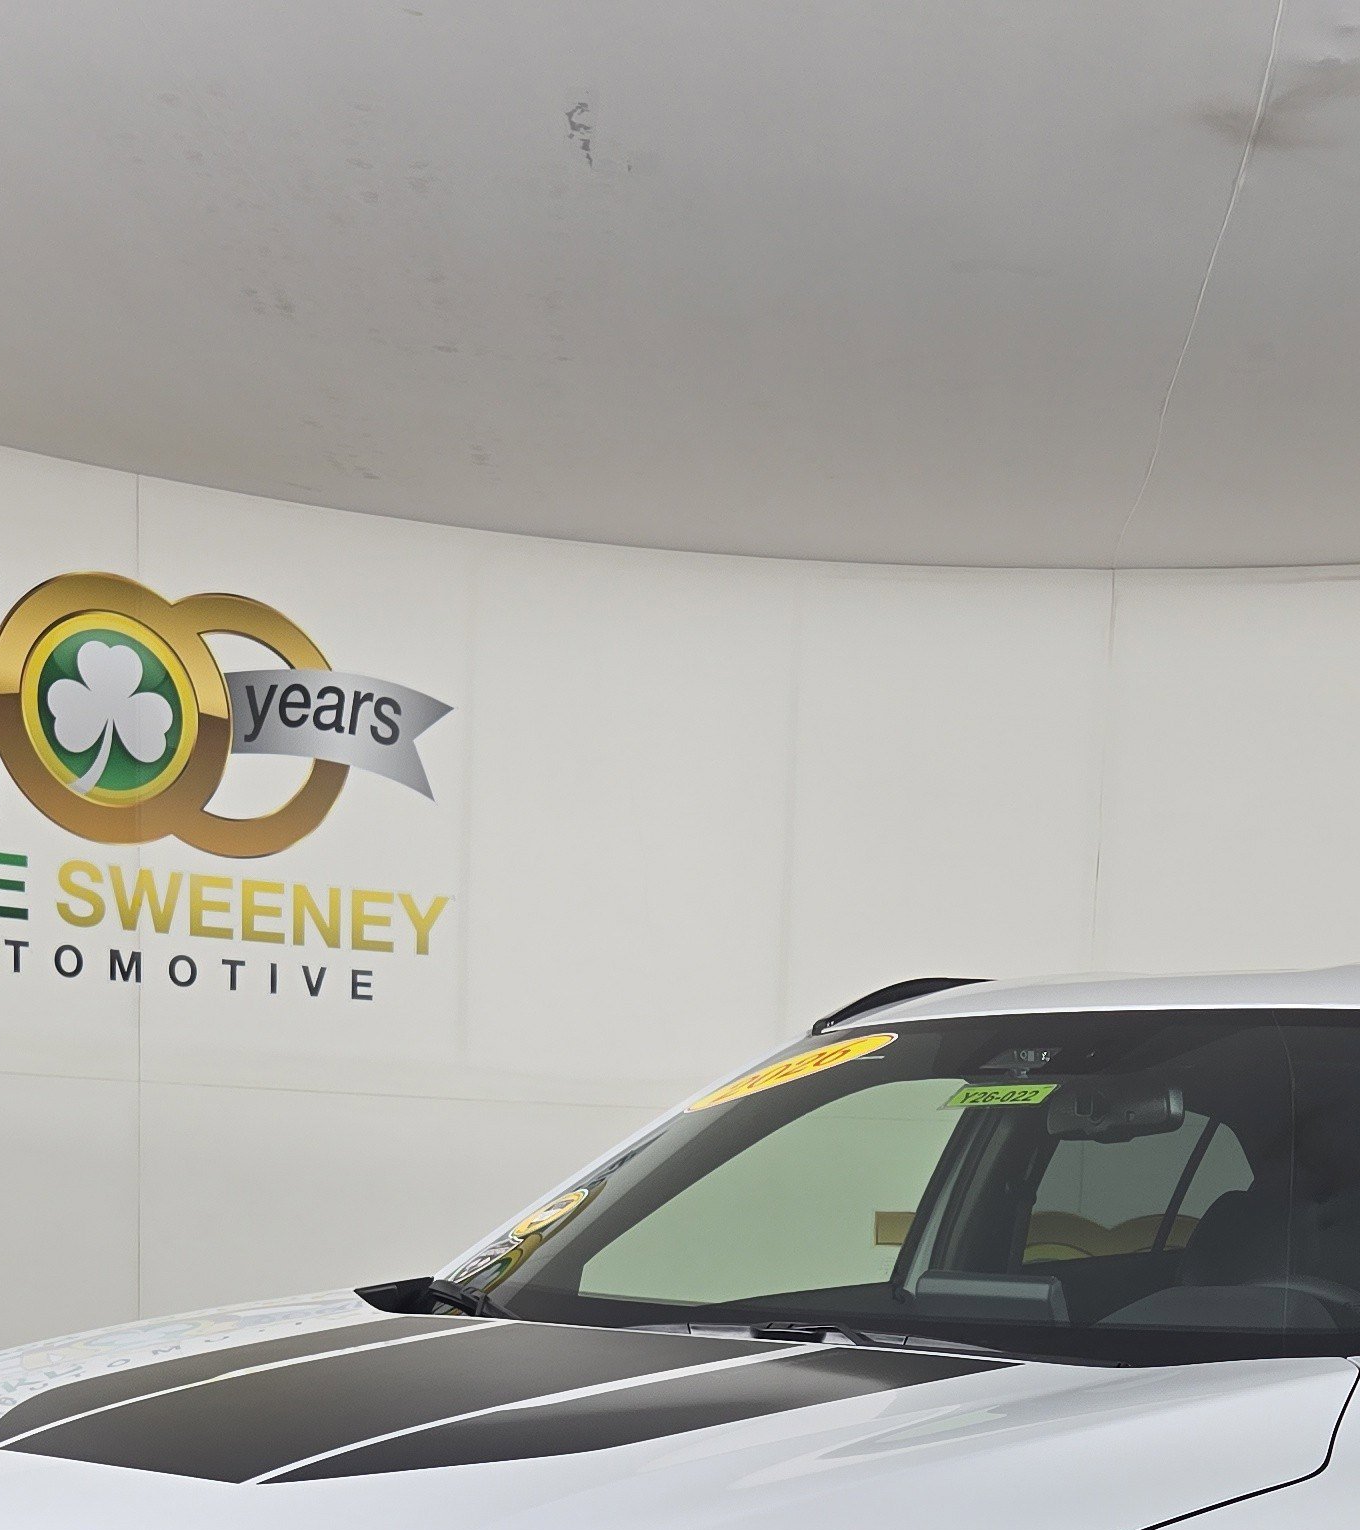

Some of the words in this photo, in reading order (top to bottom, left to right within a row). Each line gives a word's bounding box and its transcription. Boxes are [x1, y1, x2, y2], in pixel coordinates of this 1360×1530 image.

[244, 680, 402, 746] years
[55, 860, 450, 956] SWEENEY
[960, 1090, 1040, 1104] Y26-022
